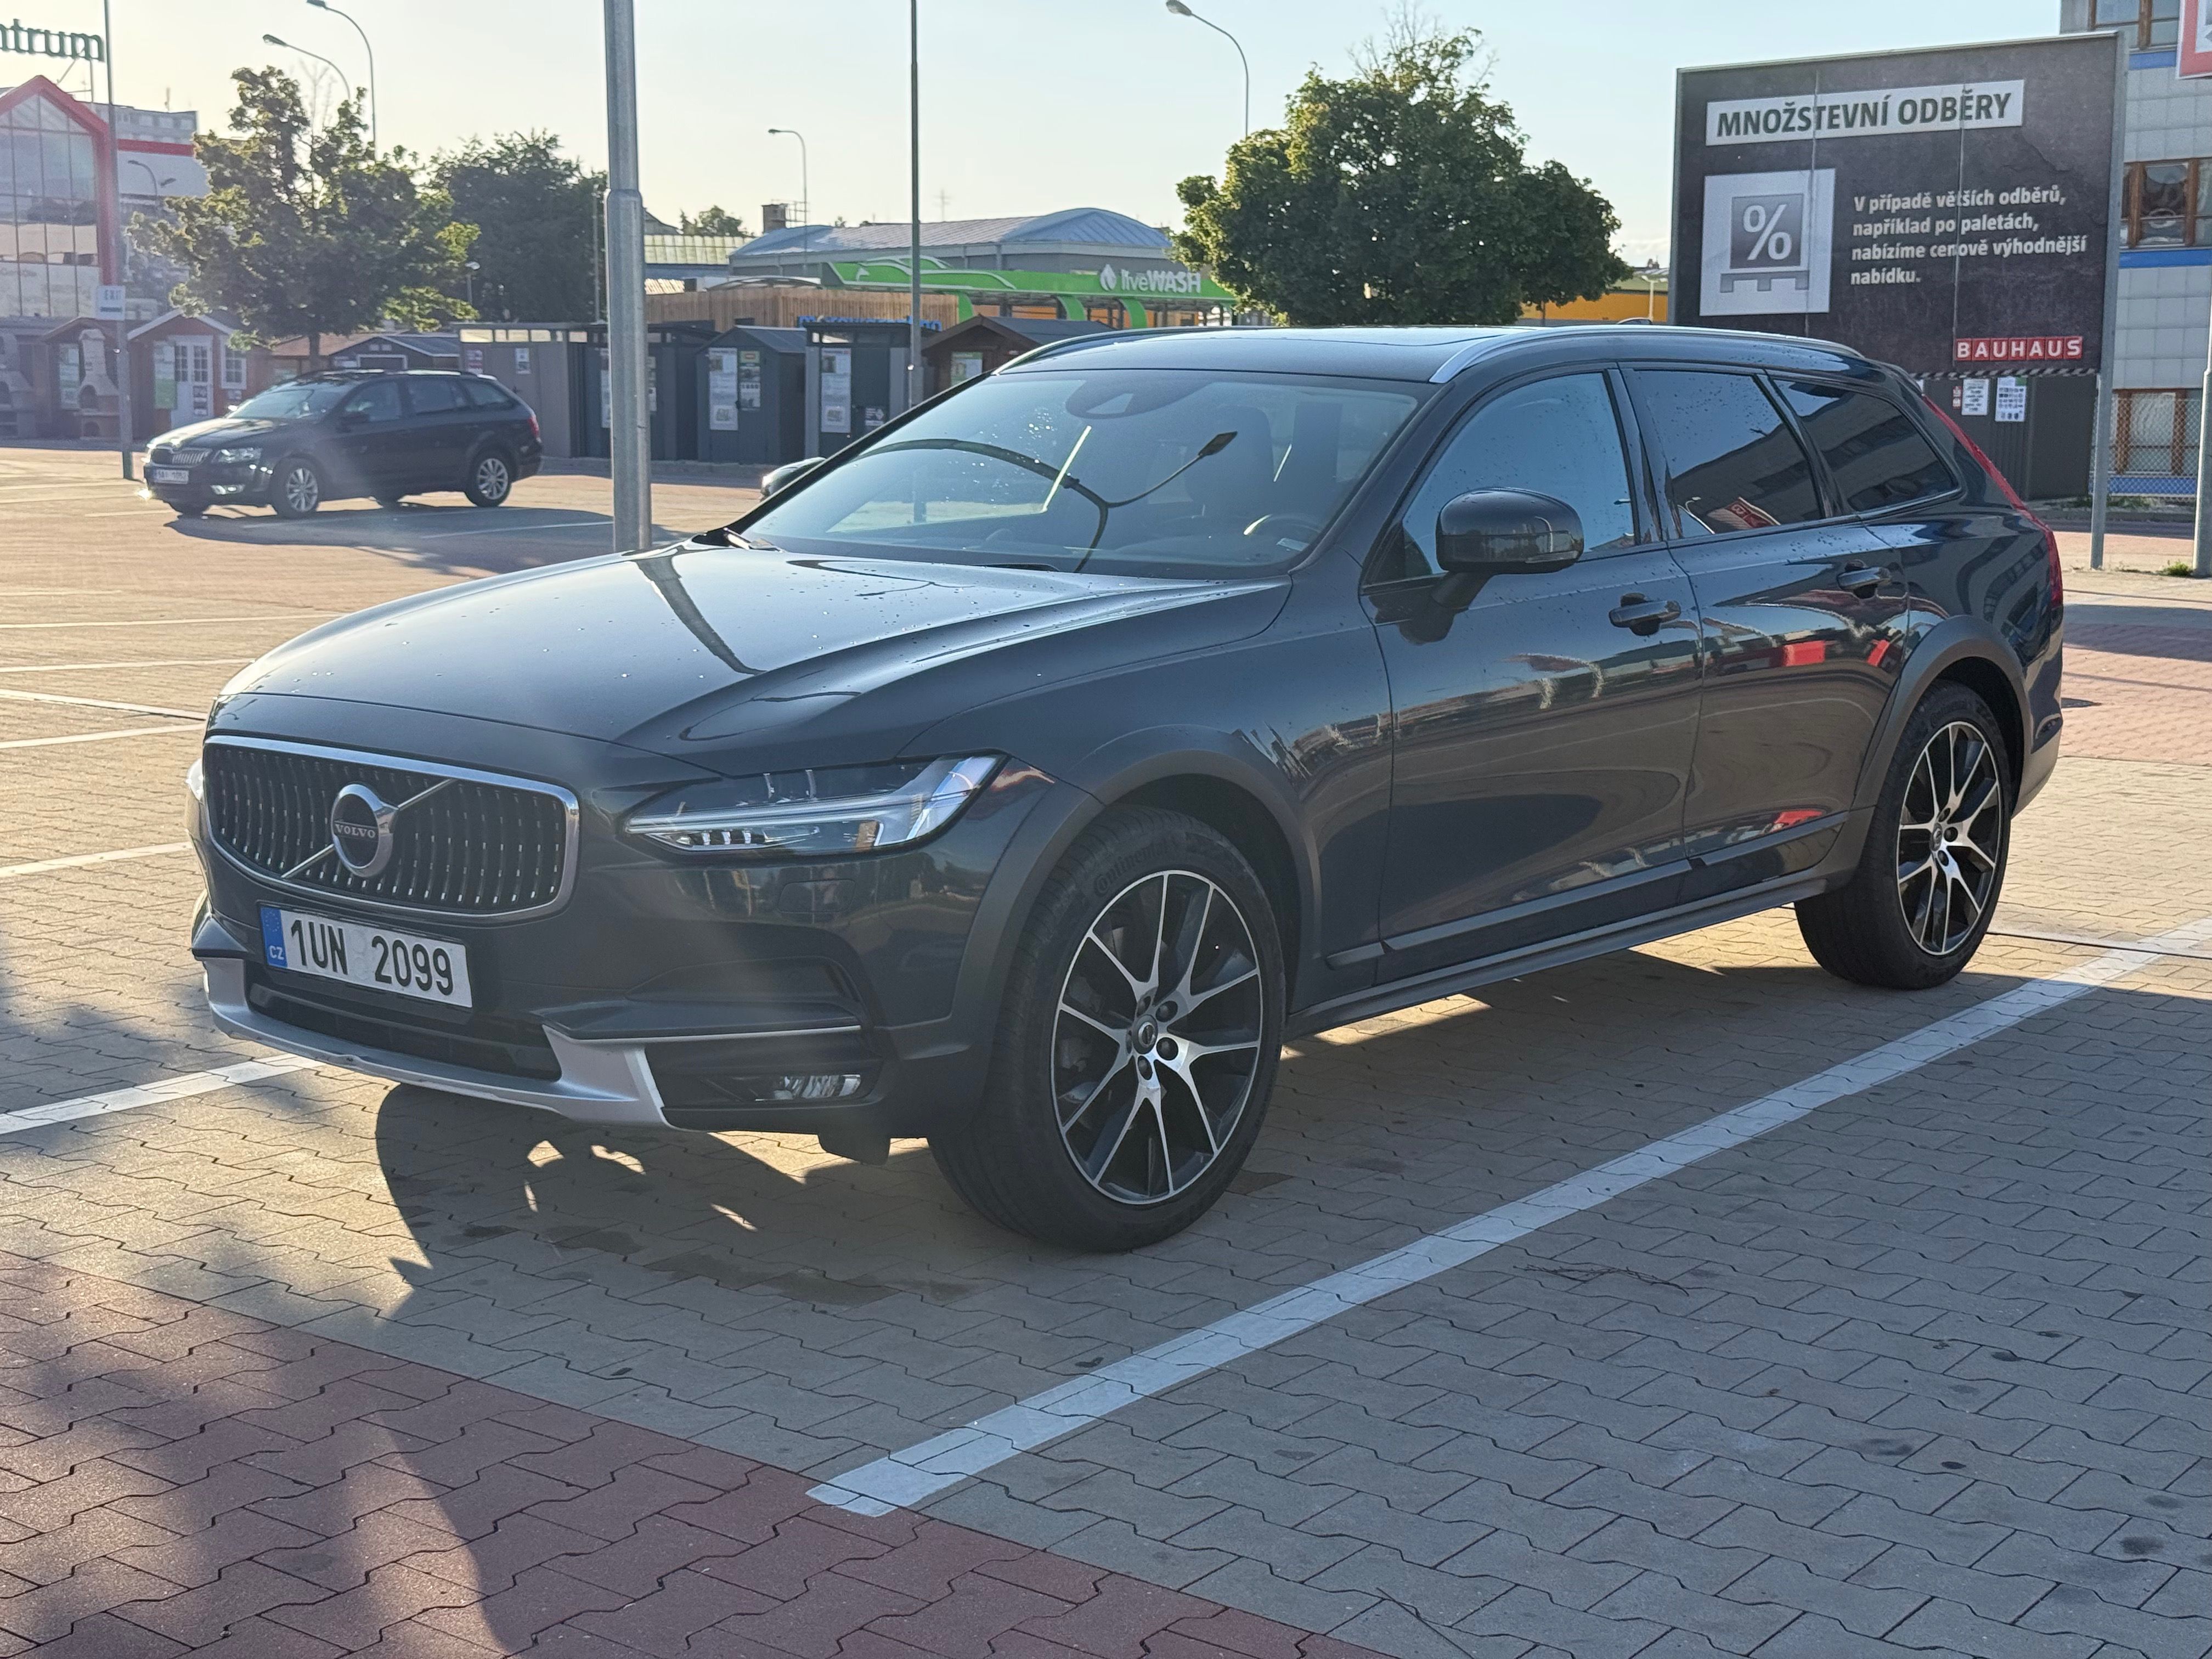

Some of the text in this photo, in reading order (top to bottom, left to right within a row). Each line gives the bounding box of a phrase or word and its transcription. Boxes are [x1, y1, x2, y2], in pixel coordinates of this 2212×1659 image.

[1717, 89, 2012, 137] MNOŽSTEVNÍ ODBĚRY
[1854, 185, 2067, 214] V případě větších odběrů,
[1743, 204, 1792, 261] %
[1853, 212, 2039, 239] například po paletách,
[1852, 235, 2089, 261] nabízíme cenově výhodnější
[1121, 269, 1201, 294] liveWASH
[1850, 267, 1921, 285] nabídku.
[1957, 339, 2081, 358] BAUHAUS
[335, 823, 376, 838] VOLVO
[269, 919, 454, 996] CZ 1UN 2099
